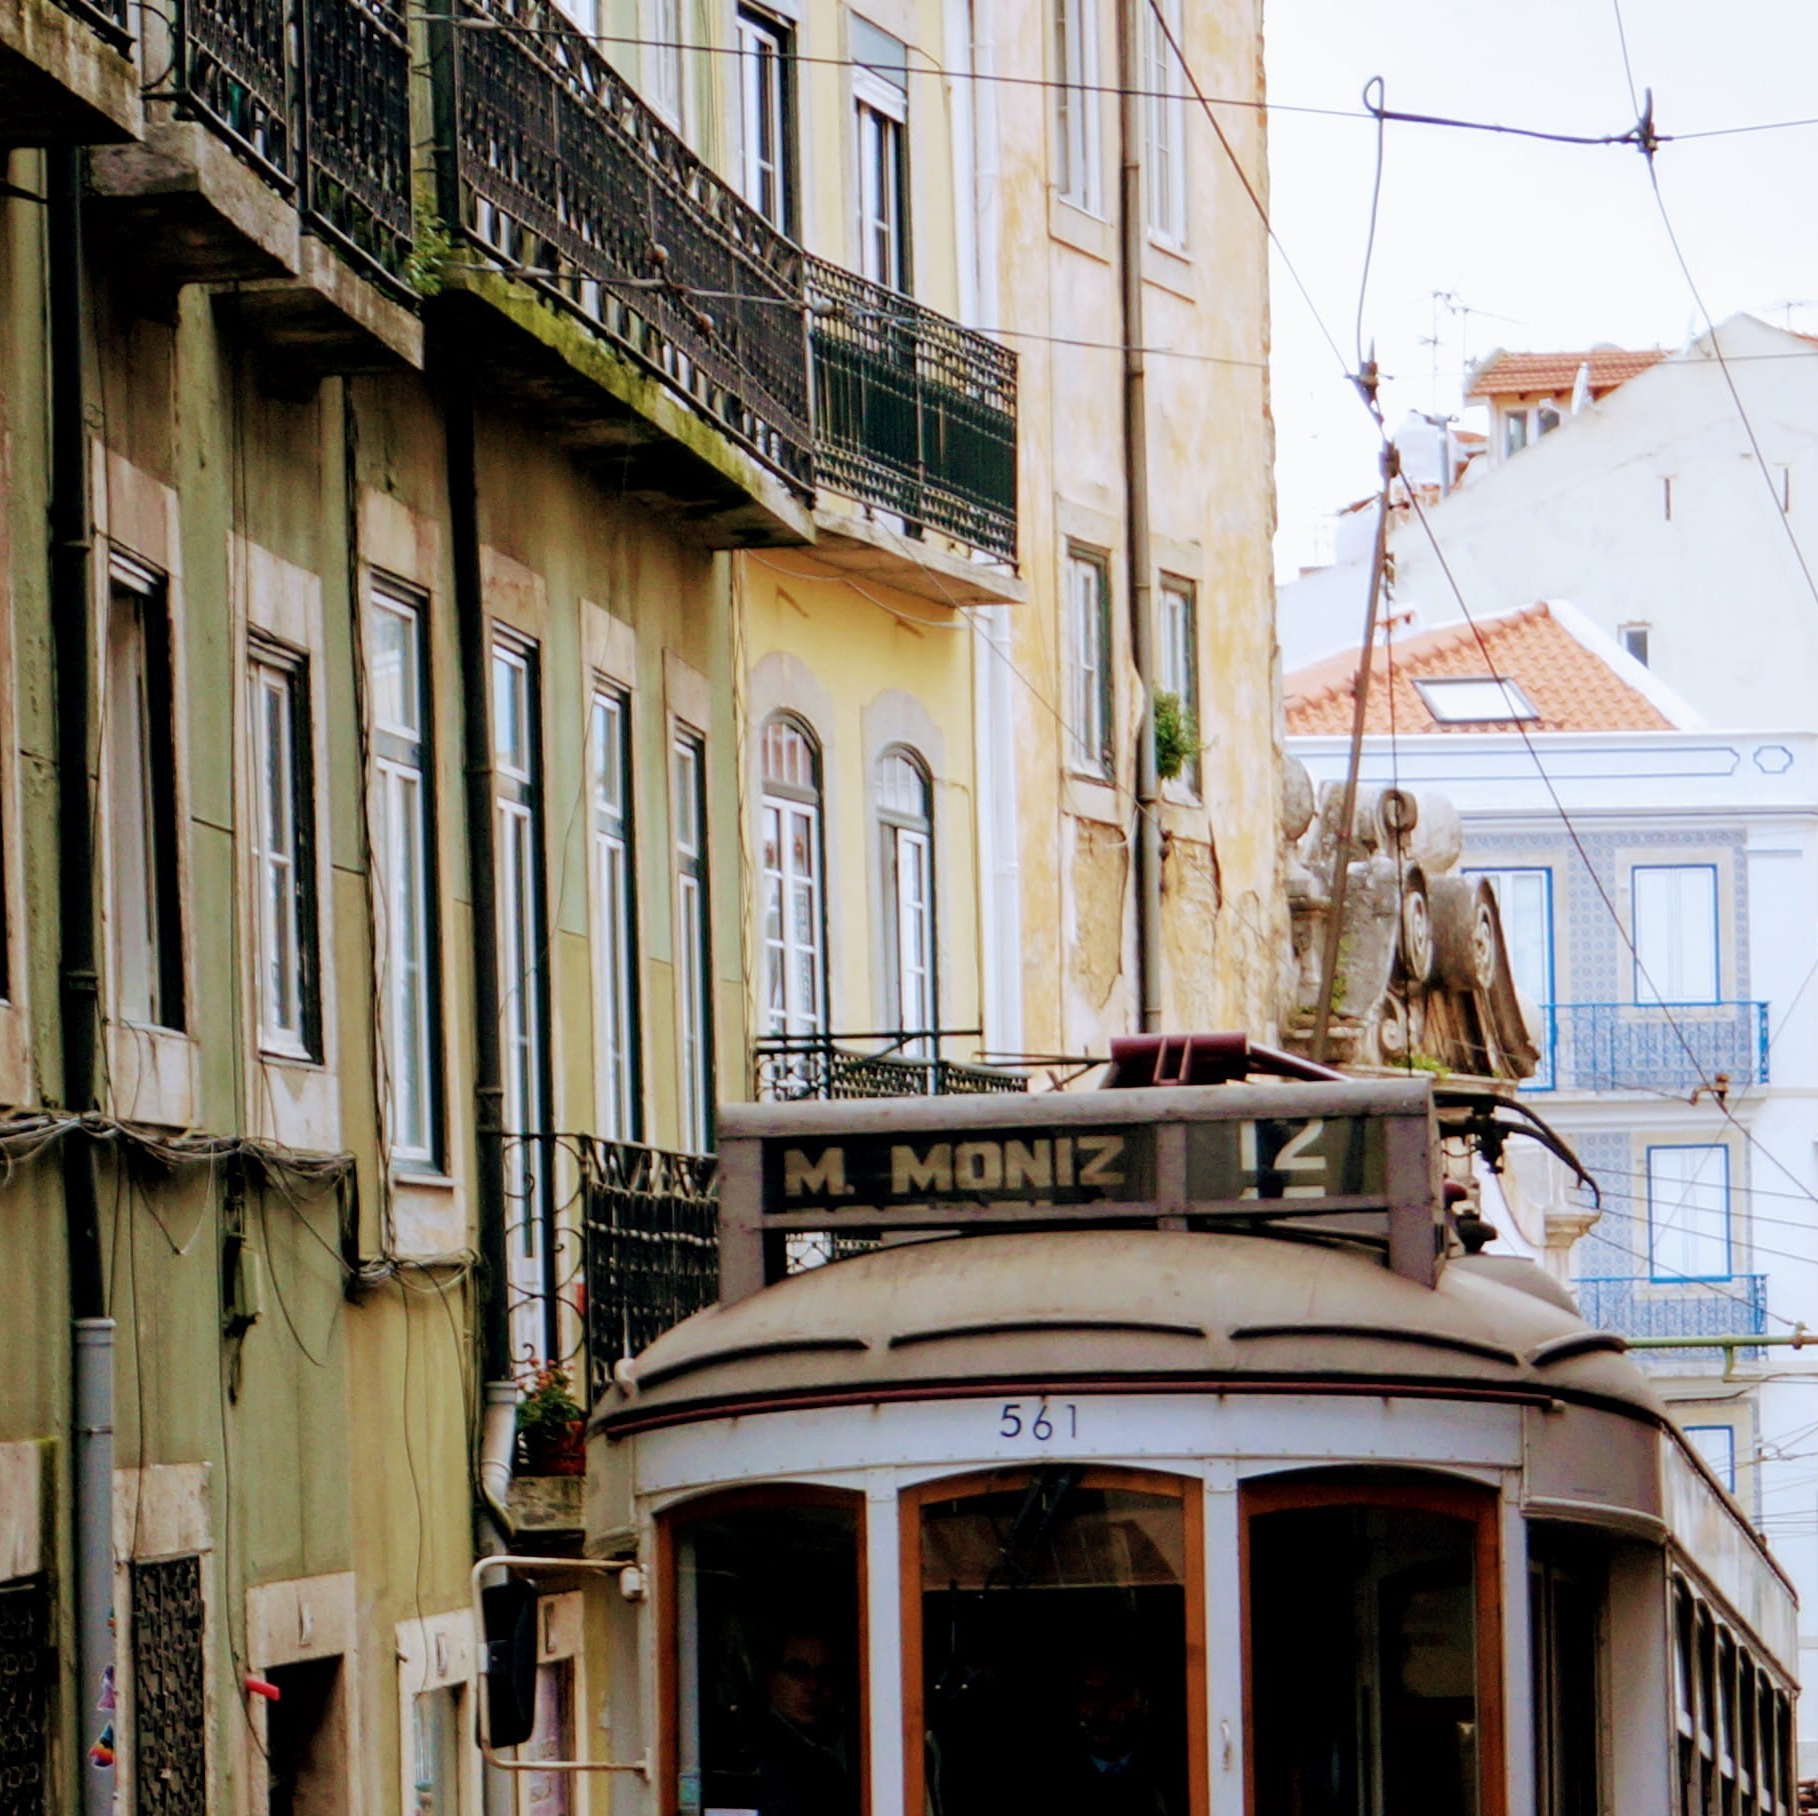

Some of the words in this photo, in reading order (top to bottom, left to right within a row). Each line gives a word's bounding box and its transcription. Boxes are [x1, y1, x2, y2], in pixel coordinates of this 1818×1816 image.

[783, 1146, 856, 1196] M.
[891, 1135, 1126, 1194] MONIZ
[1239, 1119, 1328, 1172] 12
[999, 1403, 1077, 1441] 561
